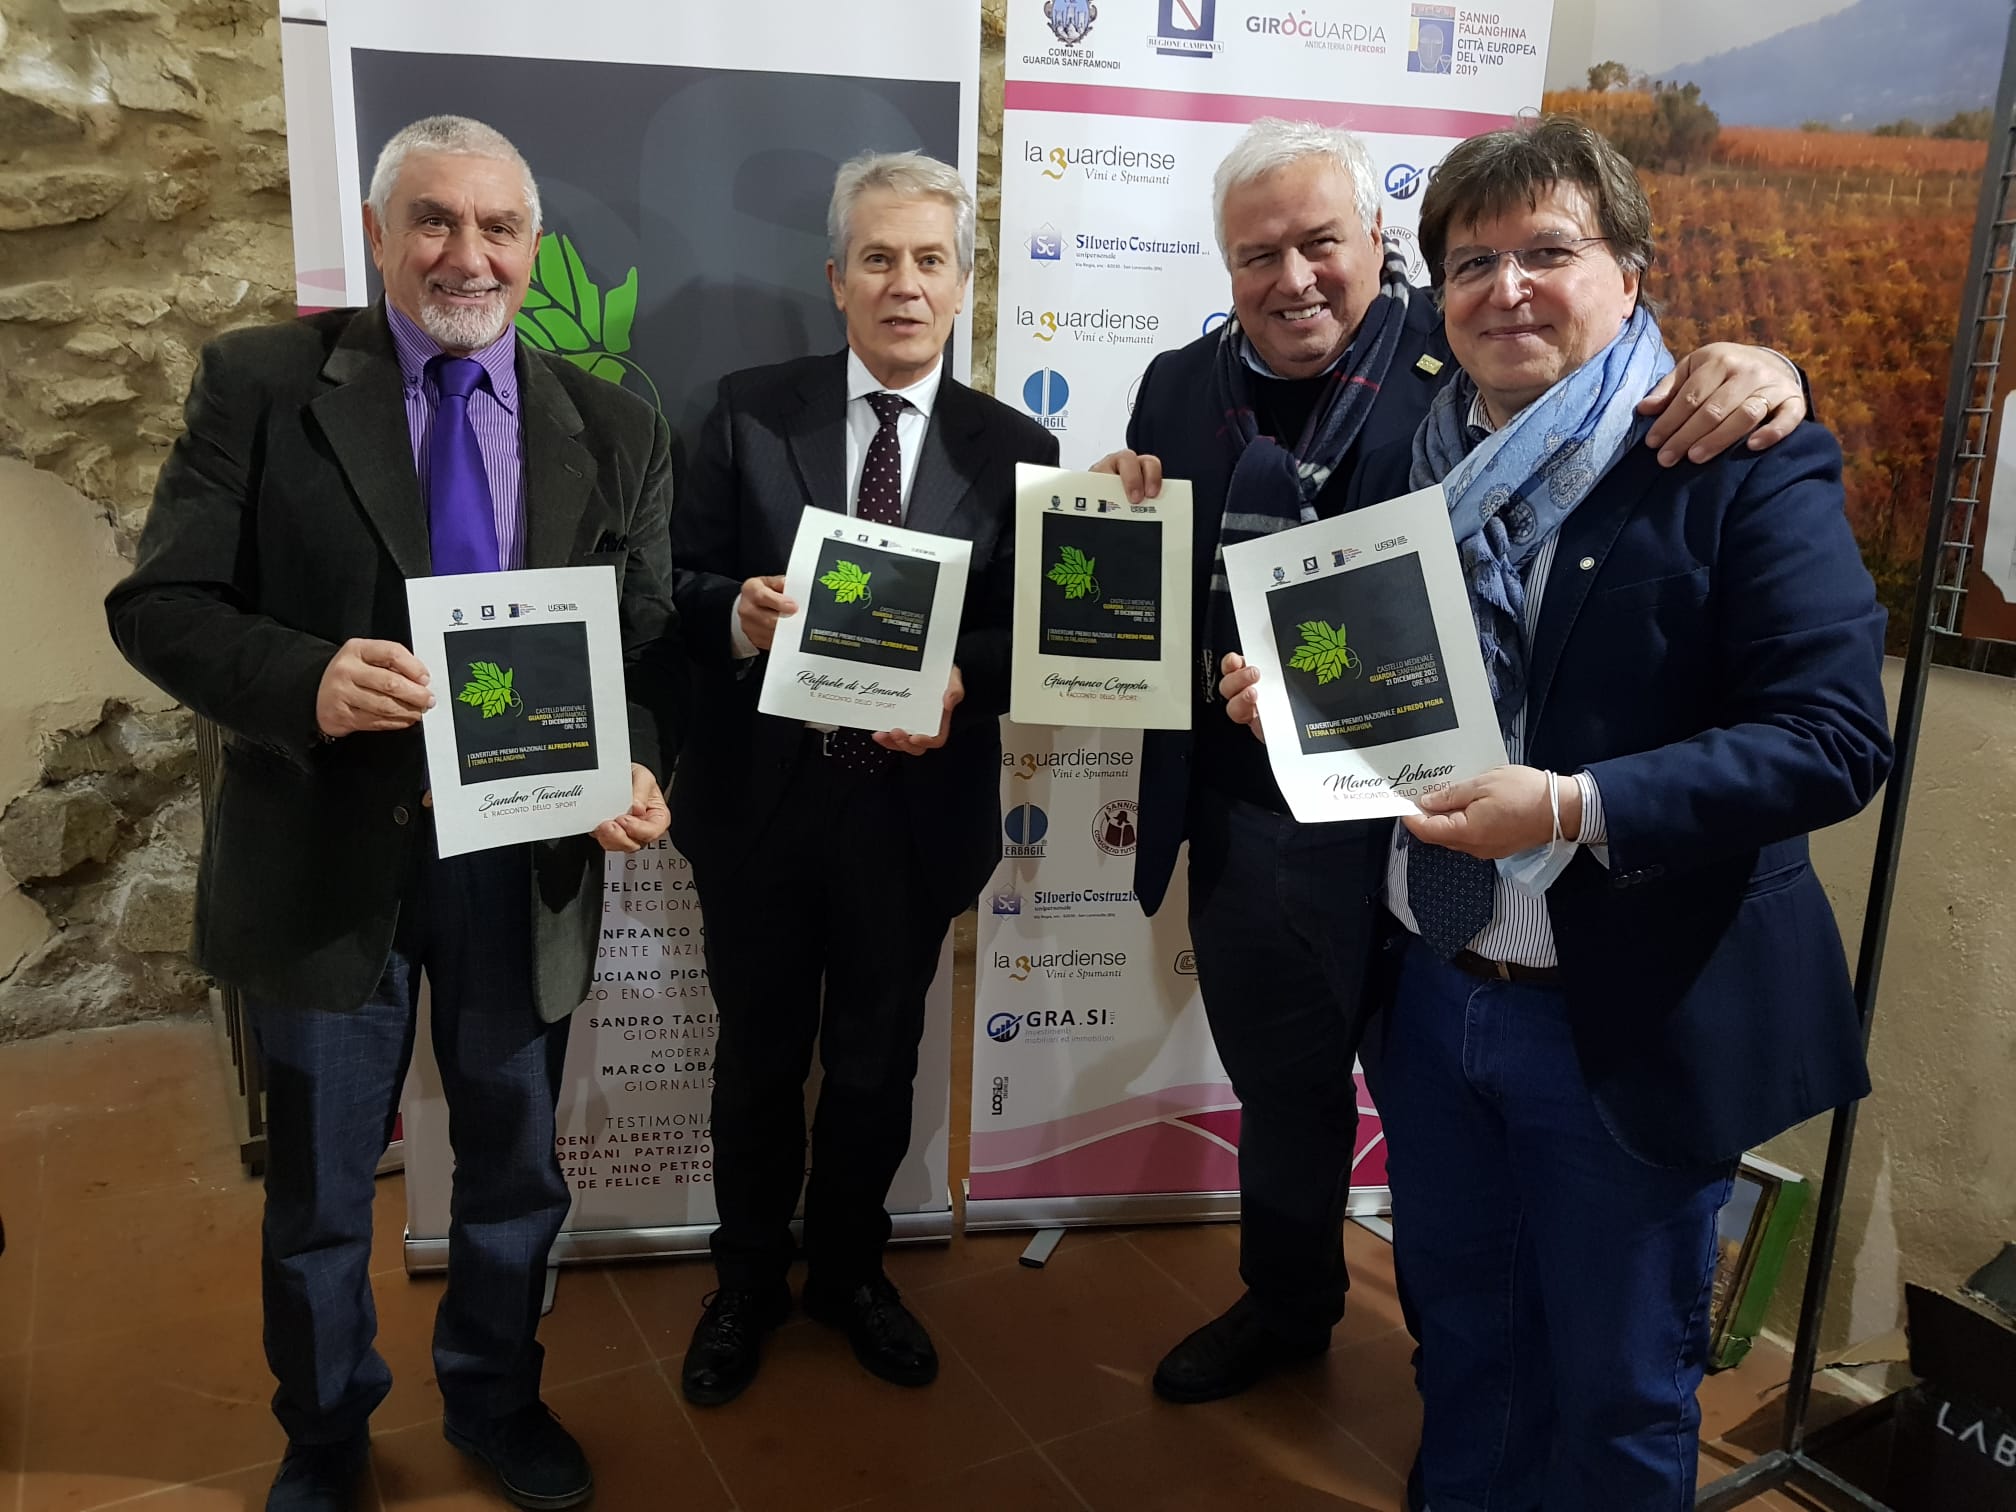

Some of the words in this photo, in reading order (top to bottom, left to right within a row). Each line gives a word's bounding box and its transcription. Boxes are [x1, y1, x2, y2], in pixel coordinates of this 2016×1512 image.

[1459, 11, 1500, 25] SANNIO
[1458, 23, 1527, 39] FALANGHINA
[1148, 38, 1181, 48] REGIONE
[1182, 41, 1222, 51] CAMPANIA
[1305, 40, 1326, 50] ANTICA
[1354, 44, 1386, 54] PERCORSI
[1457, 37, 1485, 52] CITTÀ
[1487, 41, 1536, 56] EUROPEA
[1048, 48, 1084, 58] COMUNE
[1086, 50, 1094, 58] DI
[1456, 51, 1477, 63] DEL
[1479, 53, 1504, 66] VINO
[1022, 55, 1060, 66] GUARDIA
[1061, 58, 1121, 70] SANFRAMONDI
[1455, 64, 1478, 76] 2019
[1085, 168, 1108, 181] Vini
[1111, 172, 1117, 181] e
[1120, 170, 1170, 184] Spumanti
[1076, 234, 1127, 251] Silverio
[1128, 236, 1200, 255] Costruzioni
[1074, 330, 1096, 342] Vini
[1107, 331, 1154, 345] Spumanti
[1376, 661, 1404, 673] CASTELLO
[1404, 653, 1435, 666] MEDIEVALE
[1044, 672, 1103, 693] Gianfranco
[1104, 676, 1149, 694] Coppola
[1369, 672, 1397, 683] GUARDIA
[1393, 673, 1423, 684] DICEMBRE
[1423, 668, 1437, 677] 2021
[796, 670, 845, 691] Raffaele
[844, 680, 859, 690] di
[858, 681, 912, 698] Lonardo
[1309, 720, 1341, 731] OUVERTURE
[1341, 716, 1363, 726] PREMIO
[1364, 708, 1396, 722] NAZIONALE
[1396, 702, 1424, 715] ALFREDO
[1424, 697, 1445, 708] PIGNA
[1311, 727, 1329, 737] TERRA
[1052, 768, 1073, 778] Vini
[1083, 768, 1129, 779] Spumanti
[1323, 773, 1383, 793] Marco
[1387, 763, 1456, 789] Lobasso
[1393, 788, 1418, 798] DELLO
[1422, 780, 1452, 794] SPORT
[478, 790, 529, 812] Sandro
[531, 784, 584, 804] Tacinelli
[491, 805, 529, 817] RACCONTO
[532, 803, 552, 812] DELLO
[555, 800, 577, 809] SPORT
[640, 839, 668, 850] LE
[625, 858, 688, 871] GUARD
[602, 881, 664, 892] FELICE
[1034, 891, 1082, 904] Silverio
[603, 927, 690, 939] NFRANCO
[598, 945, 649, 958] DENTE
[1046, 969, 1066, 978] Vini
[1077, 968, 1122, 979] Spumanti
[621, 985, 709, 1000] ENO-GAST
[589, 1015, 664, 1028] SANDRO
[623, 1026, 715, 1041] GIORNALIS
[651, 1047, 710, 1058] MODERA
[602, 1063, 665, 1076] MARCO
[556, 1135, 596, 1146] OENI
[608, 1130, 684, 1143] ALBERTO
[635, 1144, 710, 1156] PATRIZIO
[612, 1163, 651, 1174] NINO
[660, 1160, 712, 1171] PETRO
[577, 1180, 597, 1189] DE
[605, 1176, 661, 1188] FELICE
